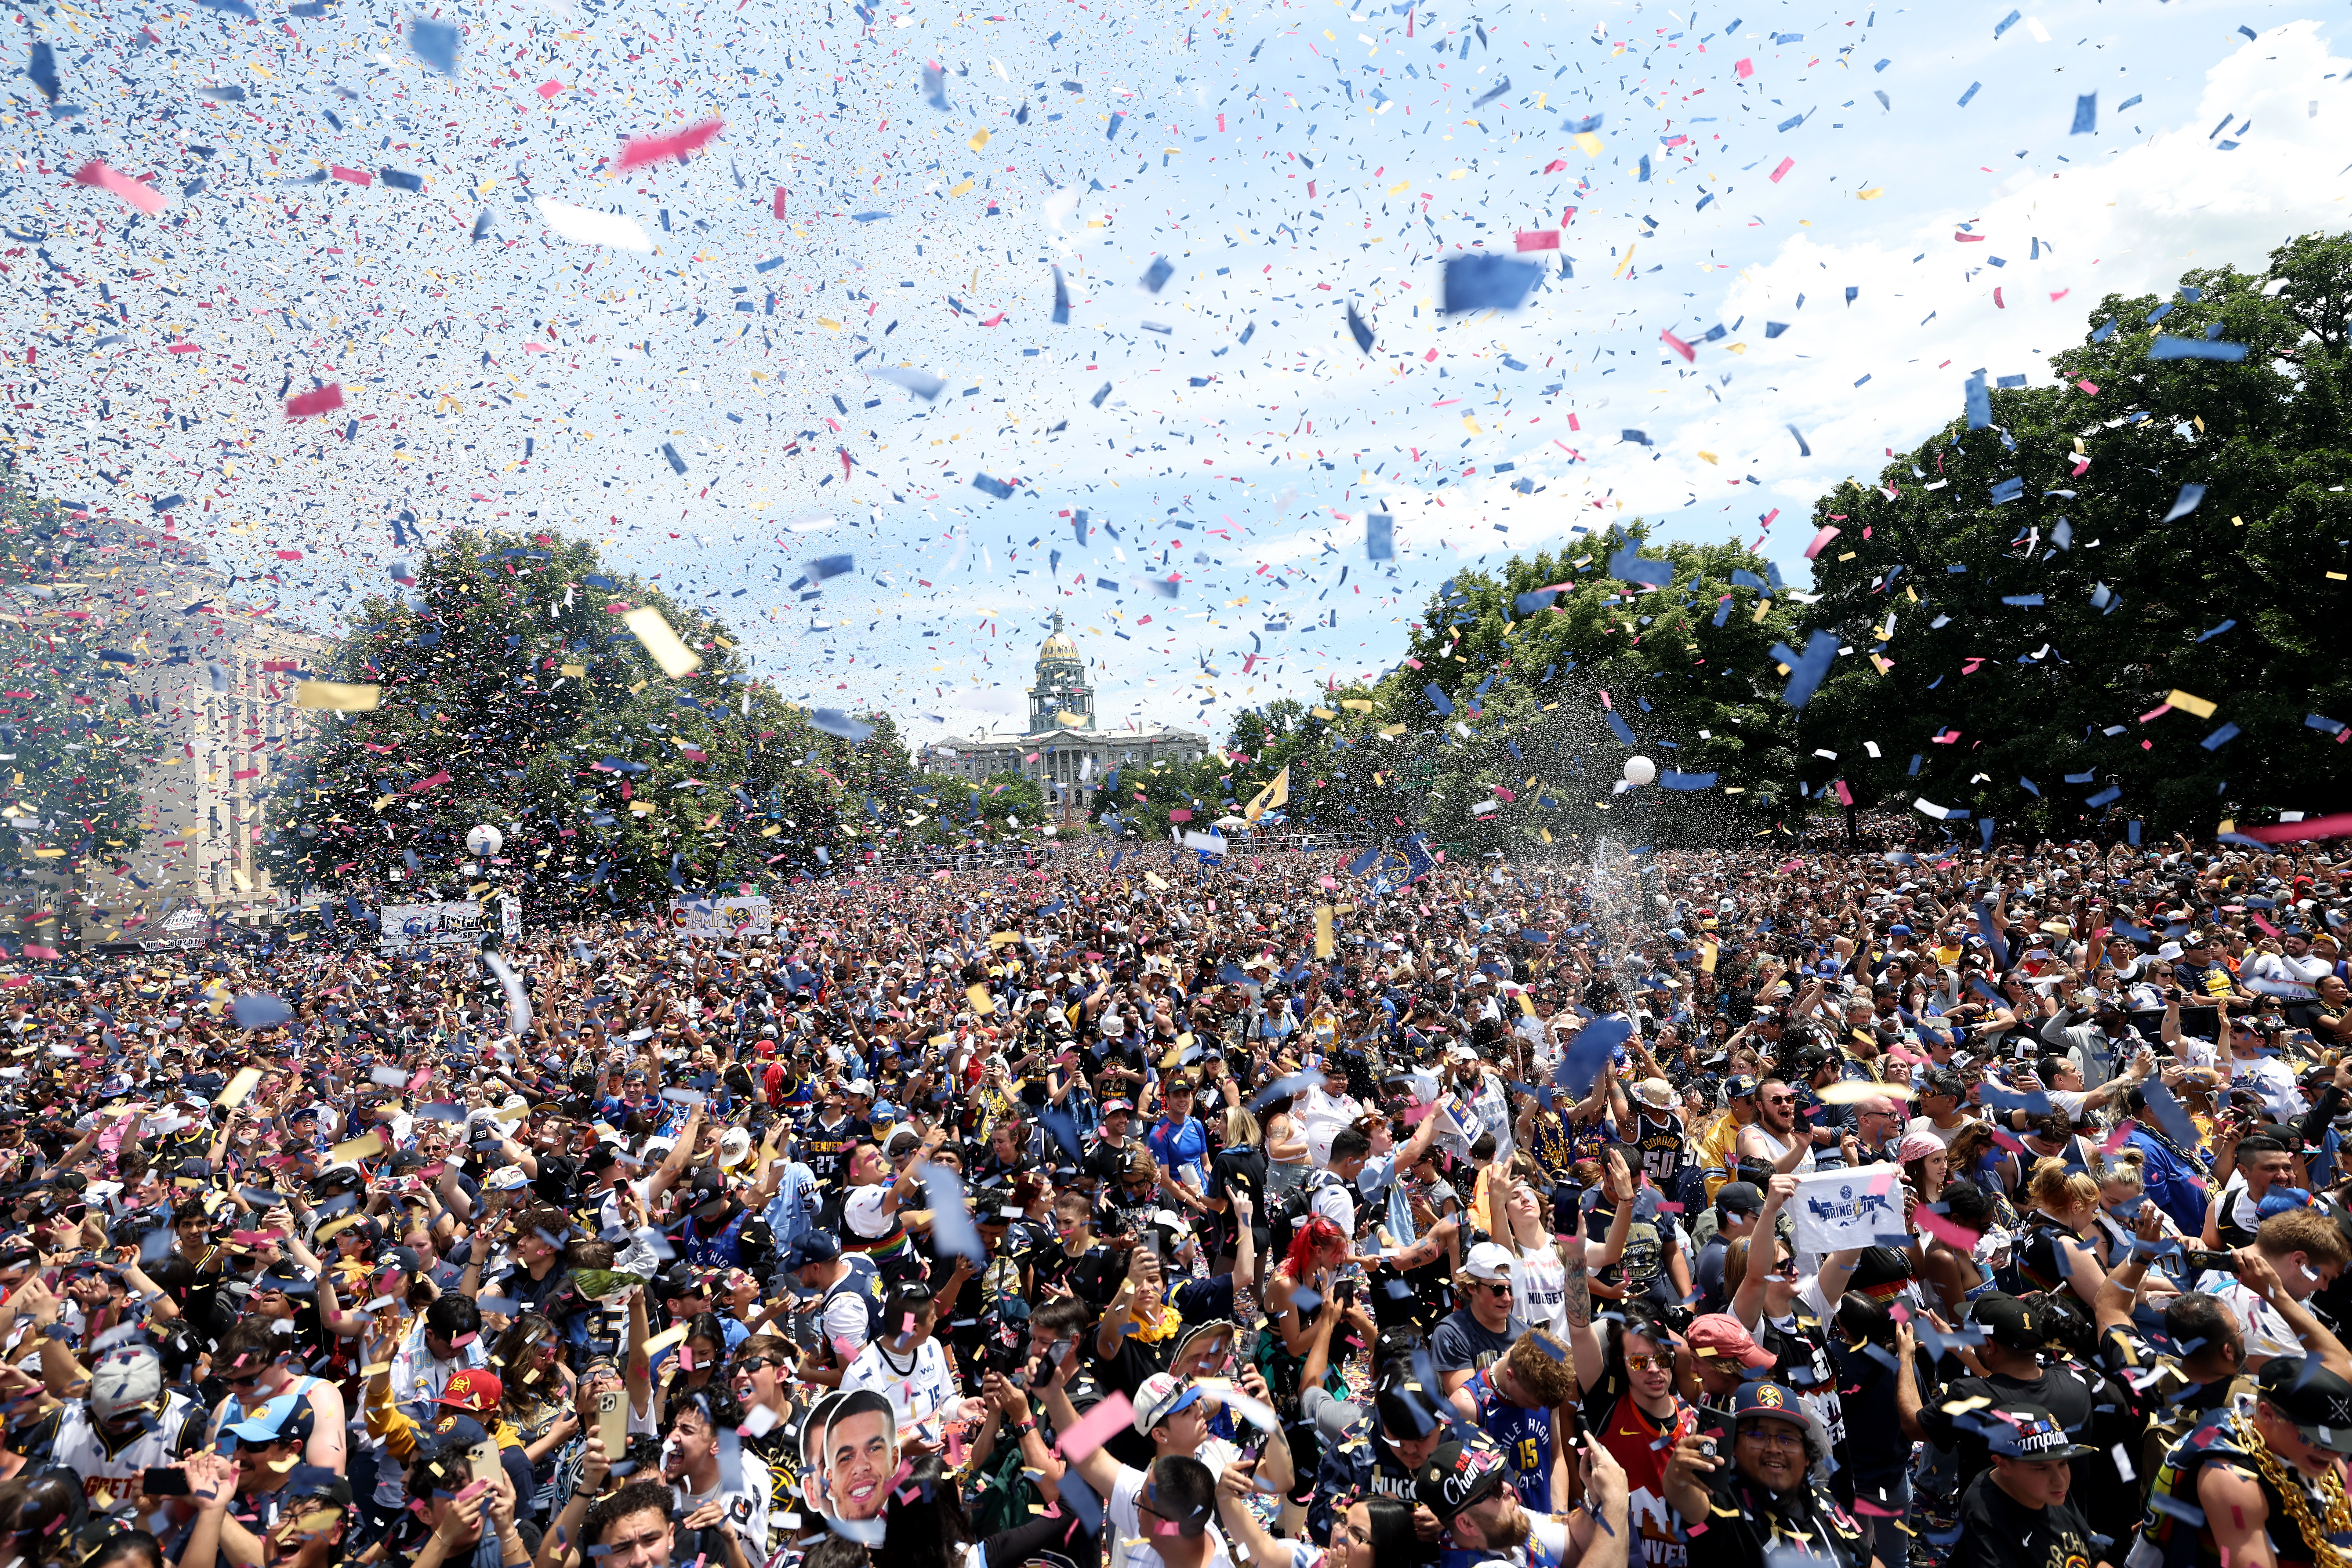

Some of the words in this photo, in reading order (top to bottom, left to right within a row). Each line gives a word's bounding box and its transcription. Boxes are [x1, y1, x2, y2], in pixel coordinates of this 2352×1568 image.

[1653, 1018, 1669, 1030] NUGG
[1952, 1052, 1973, 1069] NUGG
[1588, 1143, 1600, 1156] 15
[1642, 1136, 1679, 1150] GORDON
[817, 1155, 835, 1173] 27
[1643, 1151, 1675, 1179] 50
[1824, 1205, 1852, 1221] BRING
[1864, 1200, 1875, 1213] IN
[1528, 1290, 1564, 1305] NUGGET
[920, 1363, 935, 1375] WU
[1528, 1418, 1550, 1446] HIGH
[1517, 1437, 1539, 1470] 15
[1641, 1538, 1688, 1568] NVER
